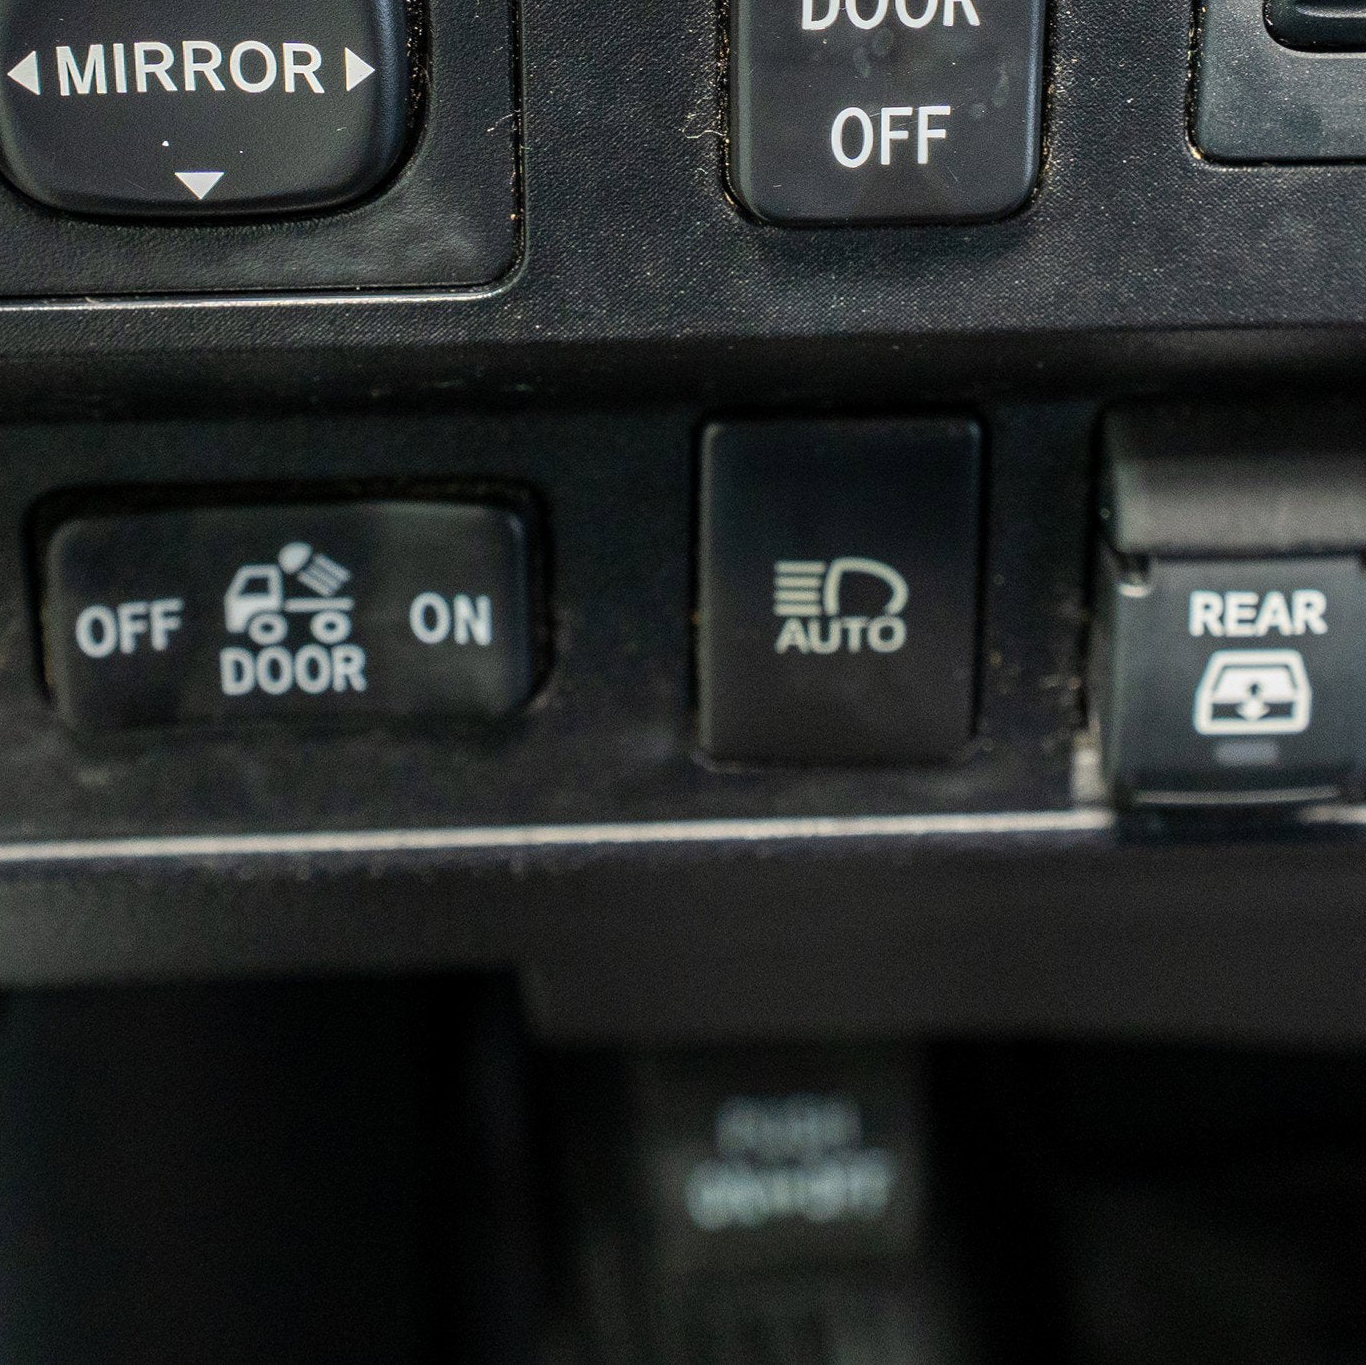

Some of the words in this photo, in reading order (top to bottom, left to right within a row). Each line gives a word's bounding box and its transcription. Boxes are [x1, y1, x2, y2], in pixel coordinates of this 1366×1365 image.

[56, 40, 325, 97] MIRROR
[830, 104, 952, 169] OFF
[76, 597, 184, 658] OFF
[409, 591, 493, 646] ON
[774, 615, 907, 655] AUTO
[1188, 589, 1329, 637] REAR
[220, 644, 368, 696] DOOR
